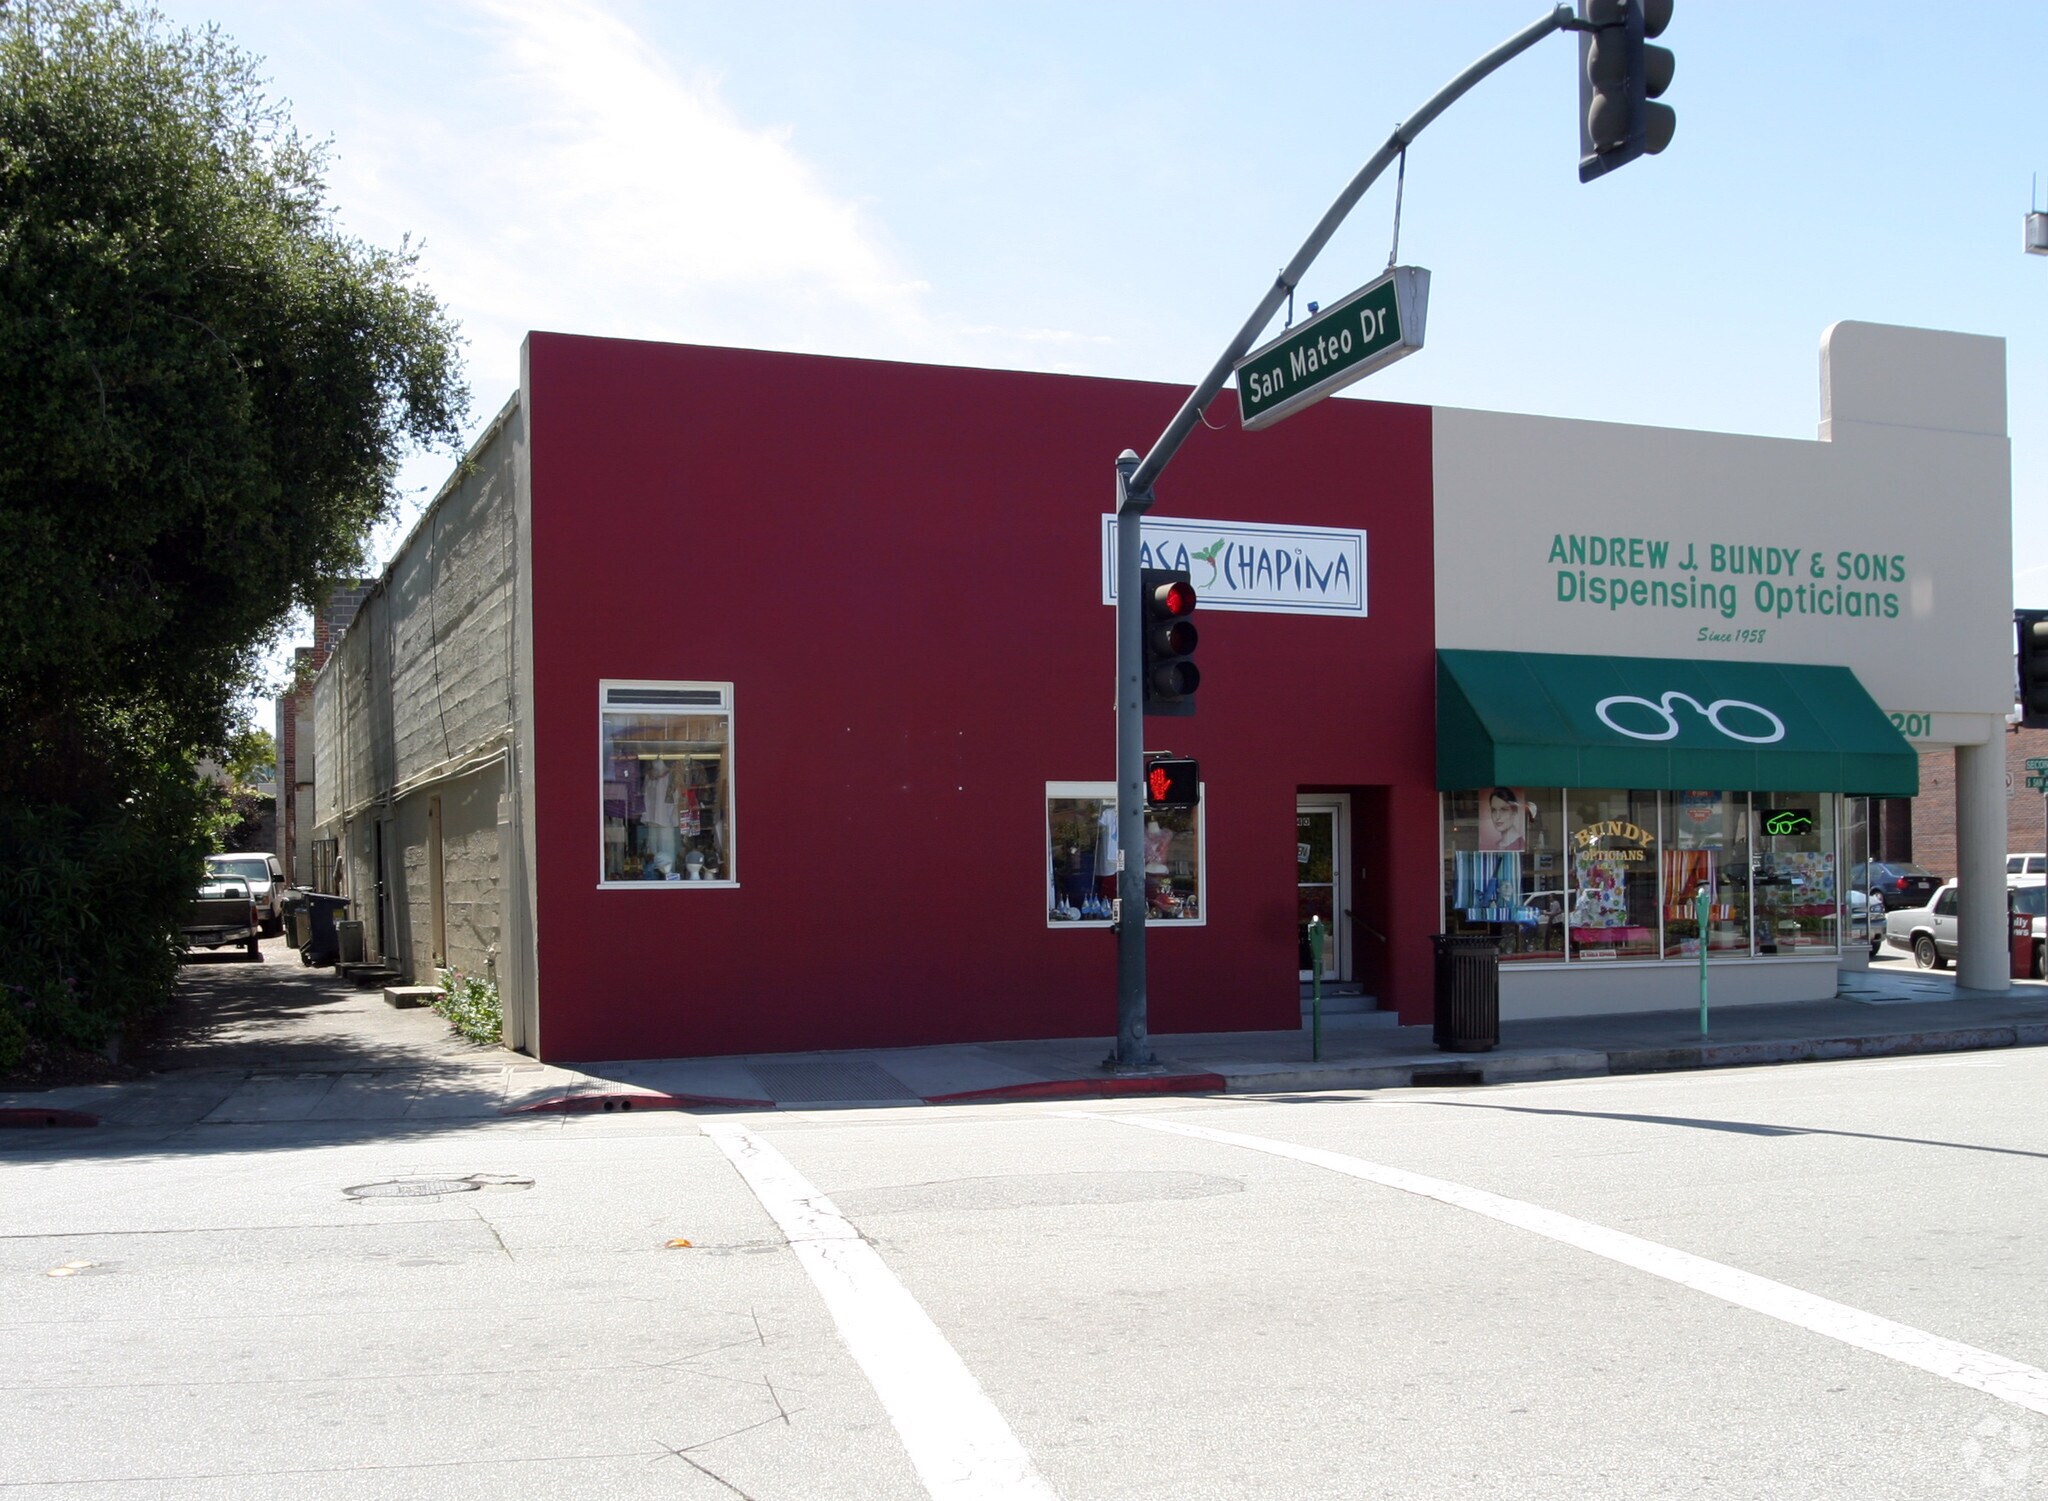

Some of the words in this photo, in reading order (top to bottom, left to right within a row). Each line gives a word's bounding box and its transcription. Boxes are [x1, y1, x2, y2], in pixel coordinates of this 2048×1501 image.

[1250, 367, 1284, 403] San
[1290, 329, 1352, 382] Mateo
[1360, 307, 1387, 344] Dr
[1140, 540, 1191, 571] ASA
[1548, 533, 1670, 570] ANDREW
[1678, 542, 1699, 572] J.
[1710, 543, 1802, 577] BUNDY
[1809, 552, 1826, 579] &
[1836, 551, 1906, 583] SONS
[1556, 570, 1737, 620] Dispensing
[1754, 580, 1900, 620] Opticians
[1696, 626, 1732, 643] Since
[1734, 628, 1767, 644] 1958
[1889, 712, 1932, 738] 201
[1575, 820, 1655, 848] BUNDY
[1582, 850, 1645, 861] OPTICIANS
